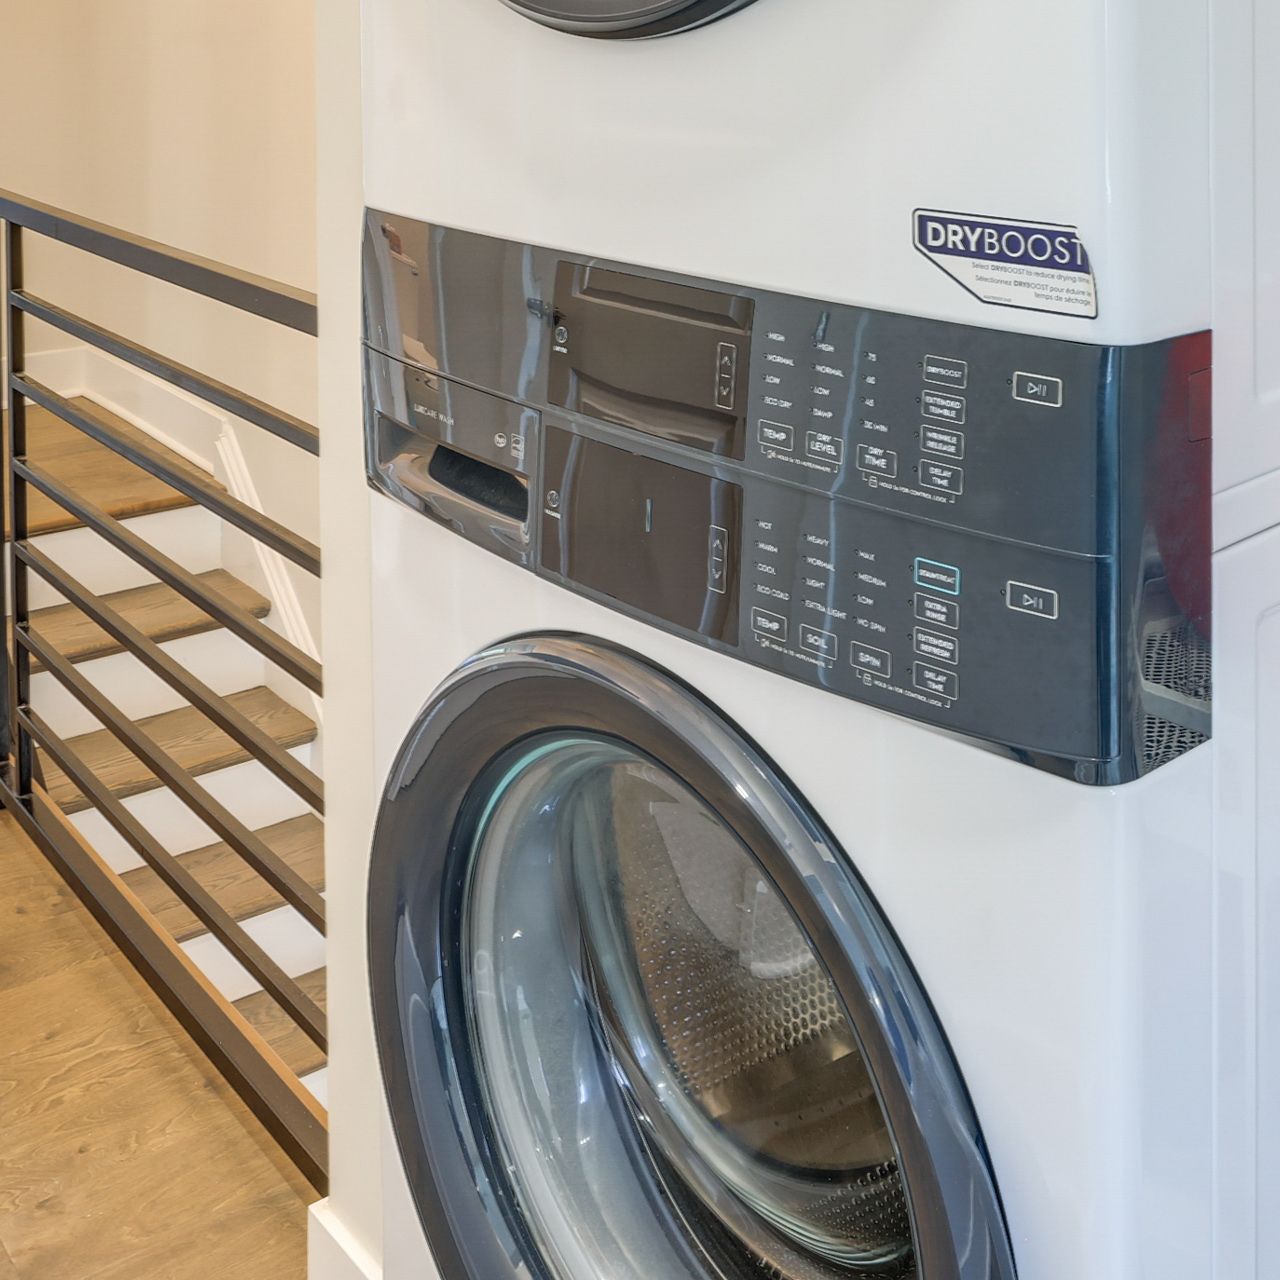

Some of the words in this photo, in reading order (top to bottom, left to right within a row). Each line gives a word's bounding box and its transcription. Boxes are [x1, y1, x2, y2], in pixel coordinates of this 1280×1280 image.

[926, 221, 1083, 265] DRYBOOST
[767, 353, 795, 366] NORMAL
[816, 364, 845, 377] NORMAL
[765, 375, 781, 384] LOW
[814, 386, 830, 395] LOW
[925, 395, 962, 409] EXTENDED
[813, 408, 833, 418] DAMP
[929, 406, 957, 418] TUMBLE
[438, 413, 455, 425] WASH
[763, 428, 787, 441] TEMP
[816, 433, 833, 443] DRY
[926, 431, 957, 444] WRINKLE
[810, 441, 838, 456] LEVEL
[867, 446, 884, 456] DRY
[926, 440, 957, 453] RELEASE
[864, 454, 887, 469] TIME
[929, 467, 953, 478] DELAY
[931, 476, 949, 487] TIME
[758, 520, 772, 530] HOT
[807, 534, 829, 546] HEAVY
[758, 542, 778, 553] WARM
[757, 563, 776, 575] COOL
[807, 557, 835, 571] NORMAL
[806, 577, 825, 589] LIGHT
[858, 573, 887, 588] MEDIUM
[857, 594, 874, 606] LOW
[924, 600, 947, 613] EXTRA
[805, 599, 826, 613] EXTRA
[826, 607, 847, 619] LIGHT
[925, 610, 947, 622] RINSE
[756, 616, 780, 632] TEMP
[806, 633, 828, 648] SOIL
[917, 632, 954, 650] EXTENDED
[920, 643, 951, 658] REFRESH
[858, 652, 881, 668] SPIN
[923, 670, 947, 683] DELAY
[926, 681, 945, 693] TIME
